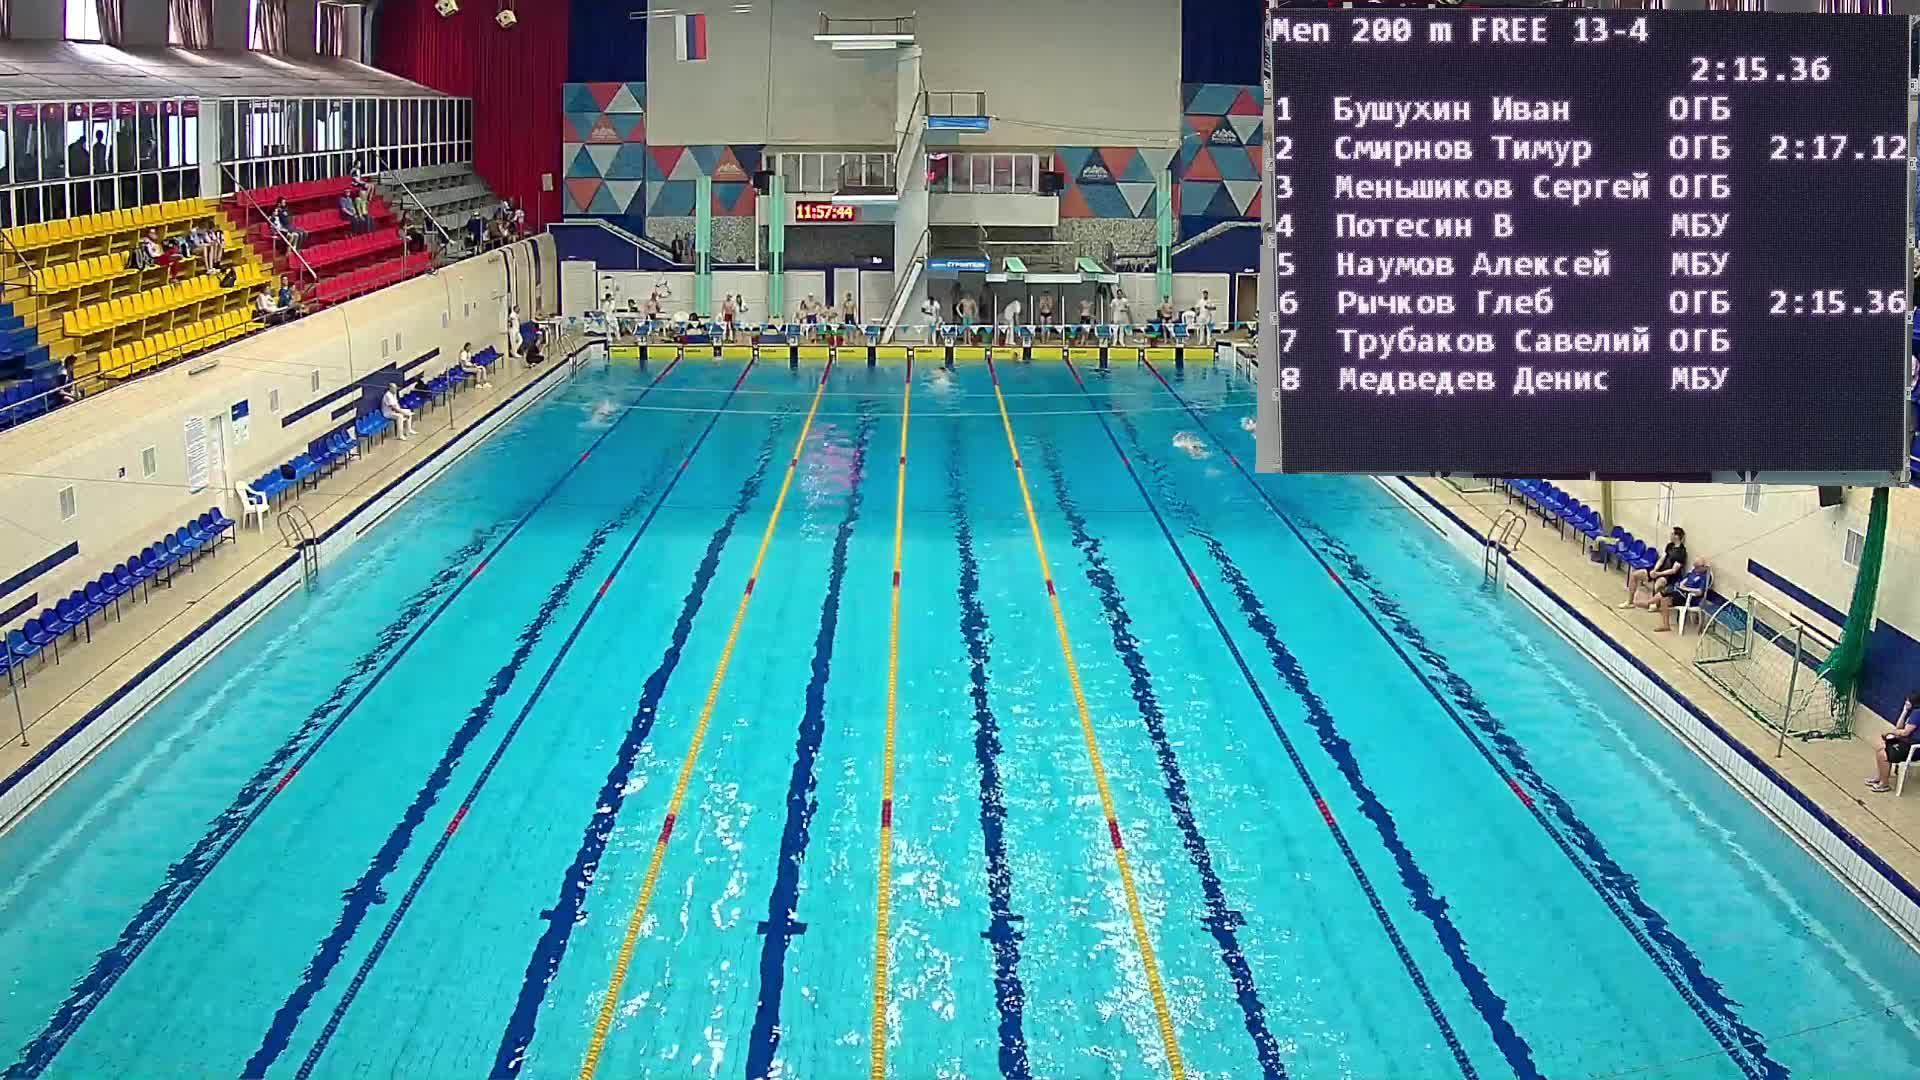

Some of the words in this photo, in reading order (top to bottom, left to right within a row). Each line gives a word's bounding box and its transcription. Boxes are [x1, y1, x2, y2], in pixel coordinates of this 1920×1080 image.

[1272, 18, 1330, 43] Men
[1352, 17, 1411, 43] 200
[1430, 22, 1452, 42] m
[1472, 17, 1547, 42] FREE
[1574, 17, 1648, 42] 13-4
[1691, 56, 1831, 82] 2:15.36
[1276, 96, 1292, 121] 1
[1334, 96, 1470, 128] Бушухин
[1492, 96, 1569, 121] Иван
[1669, 96, 1730, 121] ОГБ
[1276, 136, 1293, 160] 2
[1335, 136, 1472, 166] Смирнов
[1491, 136, 1592, 167] Тимур
[1669, 136, 1730, 160] ОГБ
[1770, 135, 1907, 161] 2:17.12
[1276, 174, 1293, 199] 3
[1335, 175, 1512, 200] Меньшиков
[1533, 172, 1649, 206] Сергей
[1669, 174, 1730, 199] ОГБ
[796, 204, 853, 219] 11:57:44
[1276, 213, 1294, 238] 4
[1336, 213, 1472, 238] Потесин
[1494, 213, 1514, 238] В
[1671, 212, 1730, 238] МБУ
[1278, 252, 1295, 276] 5
[1337, 252, 1455, 282] Наумов
[1472, 249, 1611, 277] Алексей
[1671, 251, 1730, 277] МБУ
[1279, 291, 1299, 314] 6
[1338, 290, 1456, 315] Рычков
[1476, 288, 1554, 315] Глеб
[1669, 290, 1731, 315] ОГБ
[1769, 290, 1906, 315] 2:15.36
[1280, 329, 1298, 353] 7
[1337, 326, 1496, 360] Трубаков
[1515, 327, 1650, 354] Савелий
[1669, 328, 1730, 353] ОГБ
[1280, 367, 1301, 391] 8
[1339, 367, 1496, 396] Медведев
[1513, 367, 1609, 396] Денис
[1671, 366, 1730, 392] МБУ
